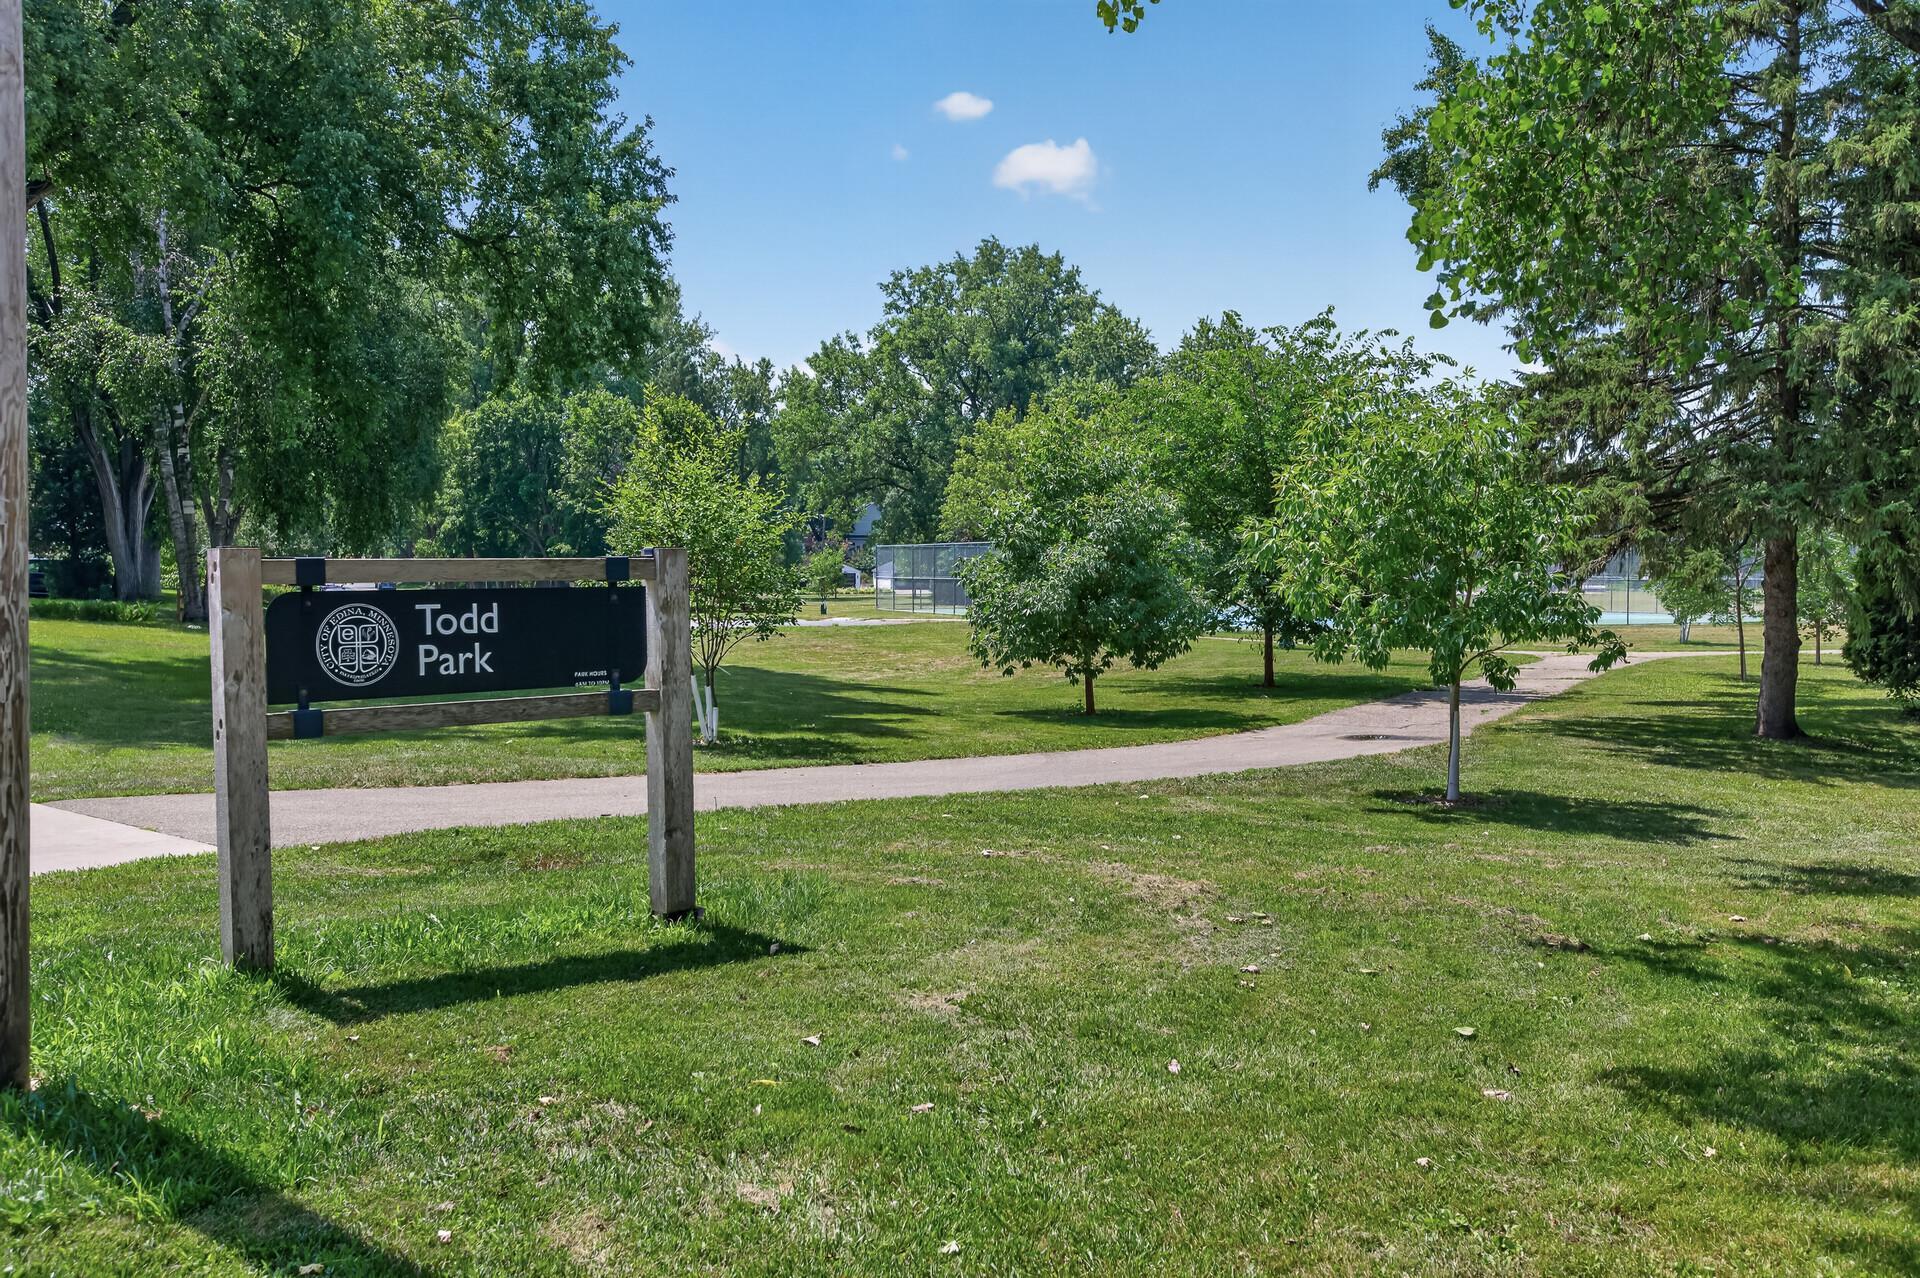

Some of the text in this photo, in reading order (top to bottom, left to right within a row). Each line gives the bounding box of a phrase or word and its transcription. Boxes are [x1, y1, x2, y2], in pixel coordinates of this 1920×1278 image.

[321, 625, 331, 641] OF
[415, 602, 498, 635] Todd
[368, 610, 396, 666] MINNESOTA
[320, 644, 335, 670] CITY
[418, 642, 494, 676] Park
